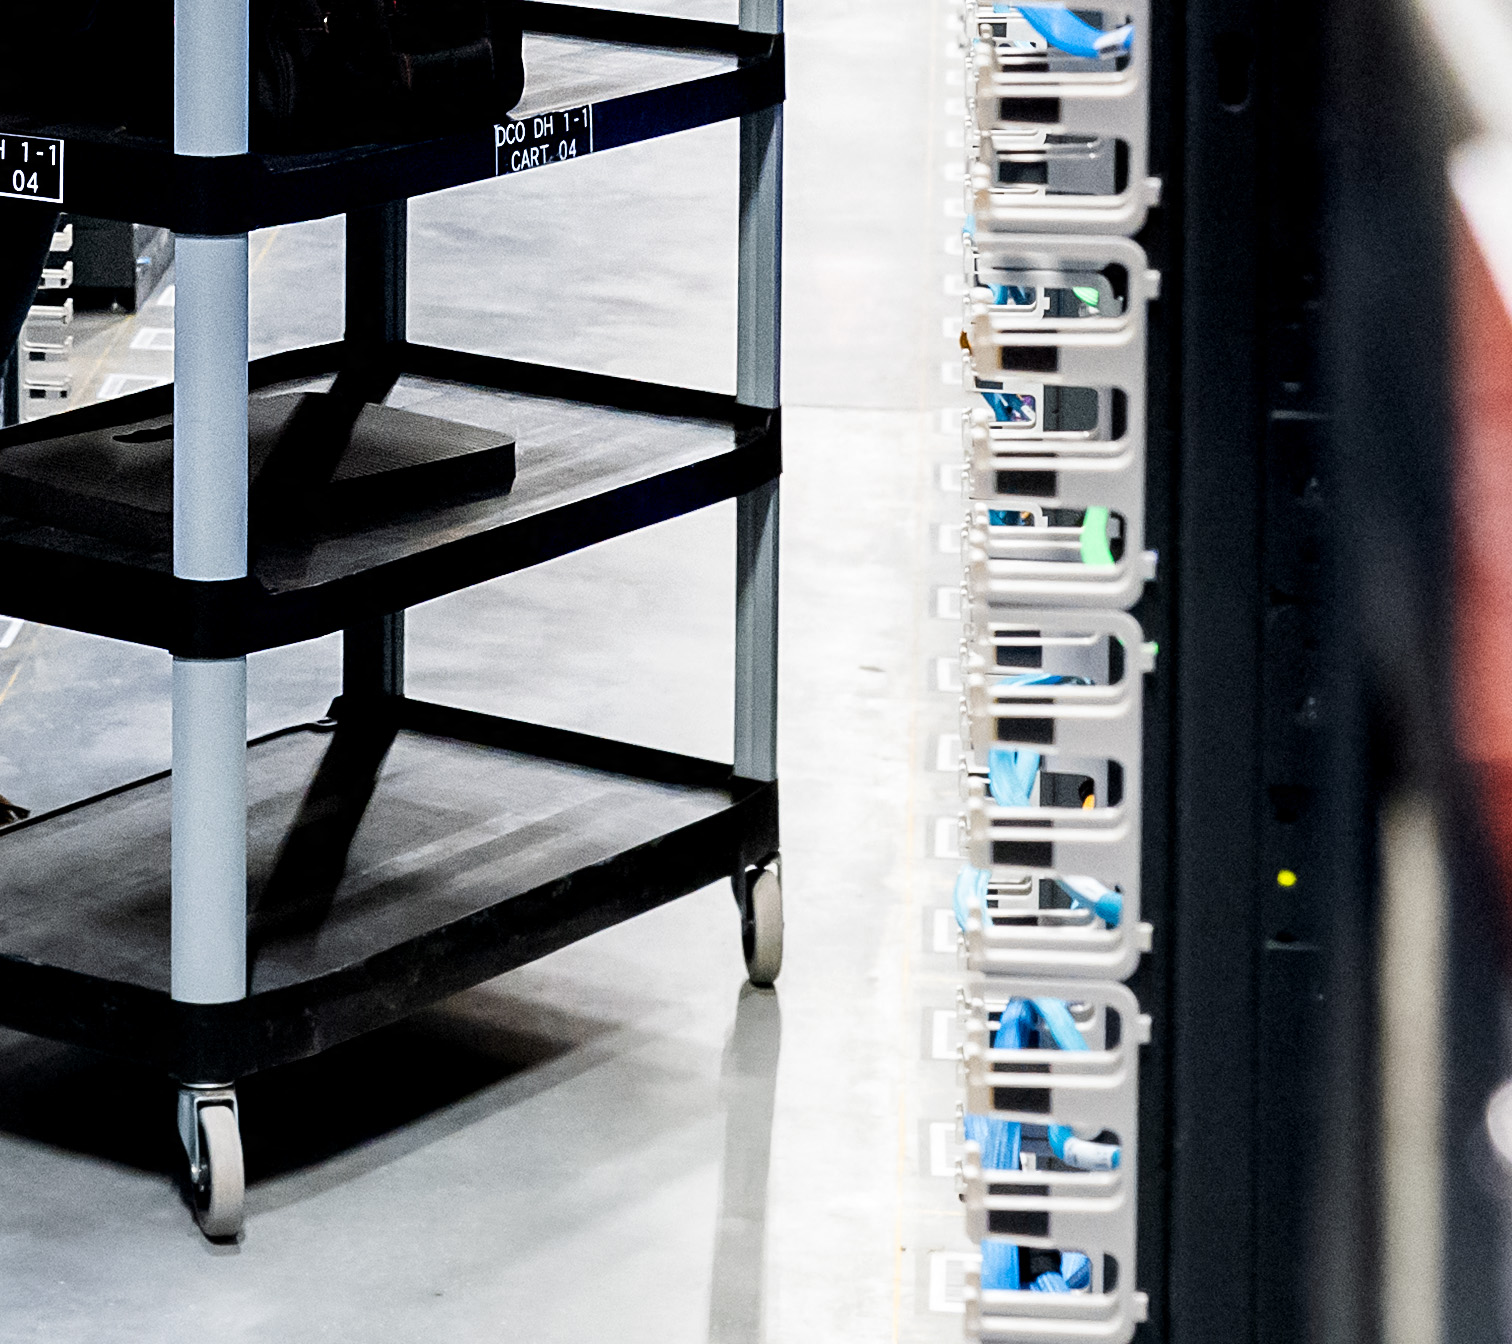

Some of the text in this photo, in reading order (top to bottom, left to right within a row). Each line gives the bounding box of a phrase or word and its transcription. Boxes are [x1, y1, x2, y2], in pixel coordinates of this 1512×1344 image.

[496, 108, 588, 147] DCO DH 1-1
[21, 141, 56, 166] 1-1
[511, 138, 577, 172] CART 04
[12, 169, 39, 194] 04
